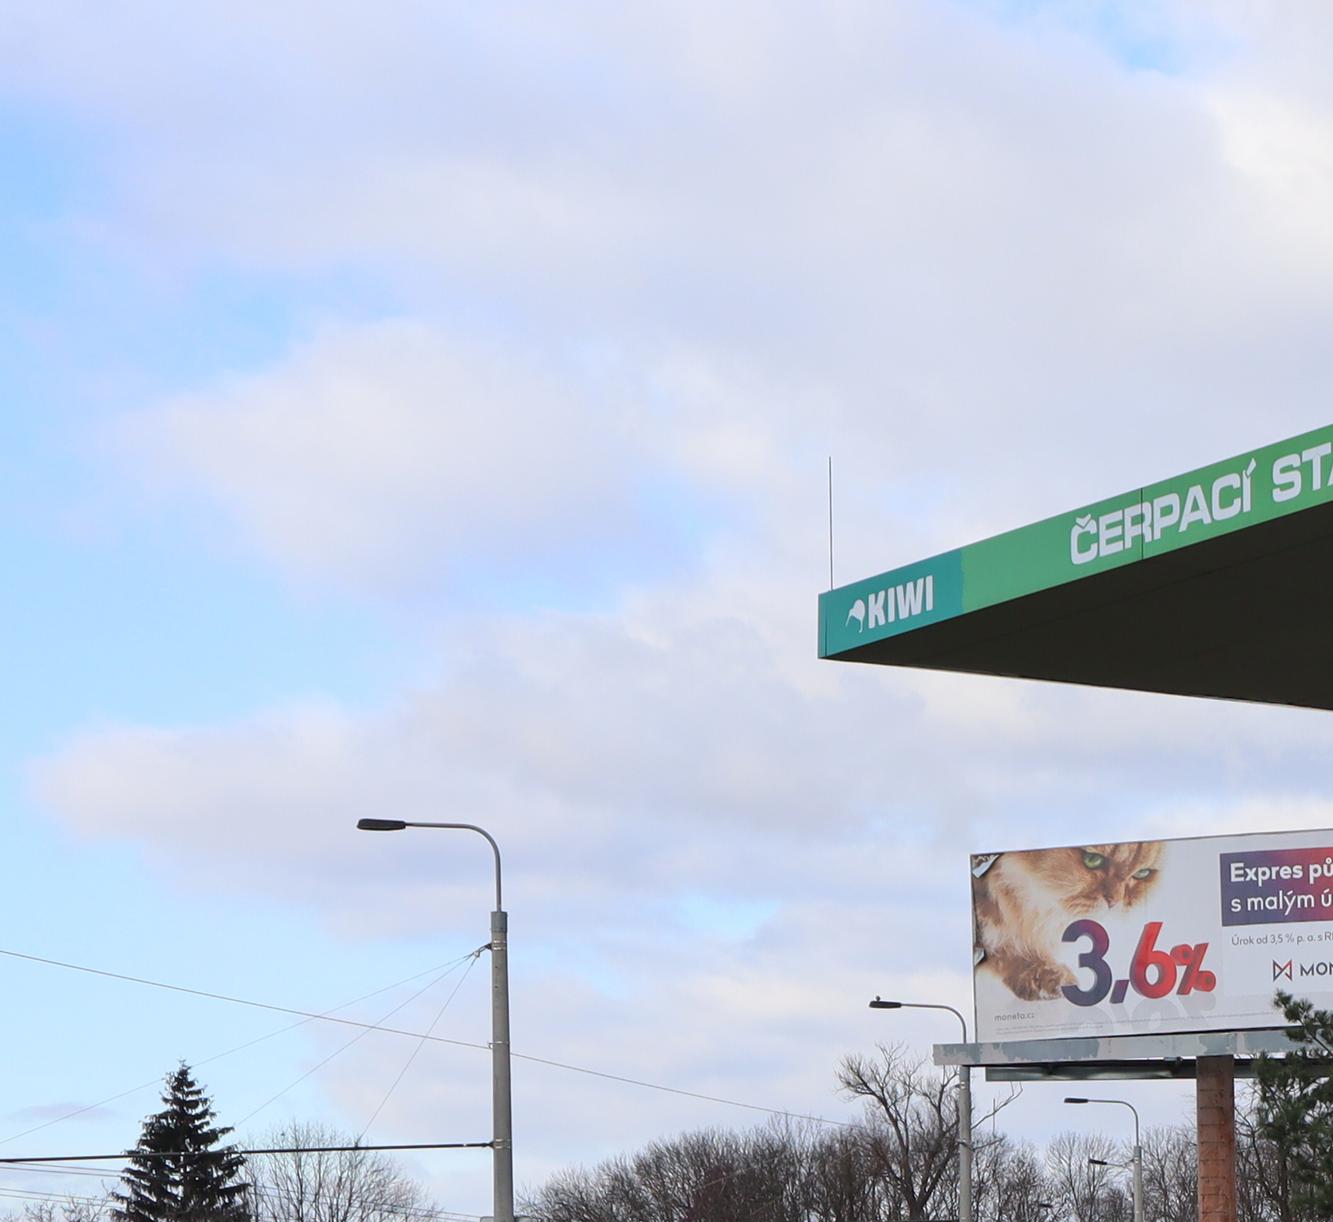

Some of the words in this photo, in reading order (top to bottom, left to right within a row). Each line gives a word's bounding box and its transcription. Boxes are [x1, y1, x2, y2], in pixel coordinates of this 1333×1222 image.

[1070, 458, 1256, 565] ČERPACÍ
[868, 575, 934, 629] KIWI
[1230, 862, 1303, 887] Expres
[1230, 897, 1242, 912] s
[1247, 890, 1315, 916] malým
[1232, 934, 1253, 946] Úrok
[1256, 935, 1268, 945] od
[1270, 934, 1284, 945] 3,5
[1061, 919, 1217, 1007] 3,6%
